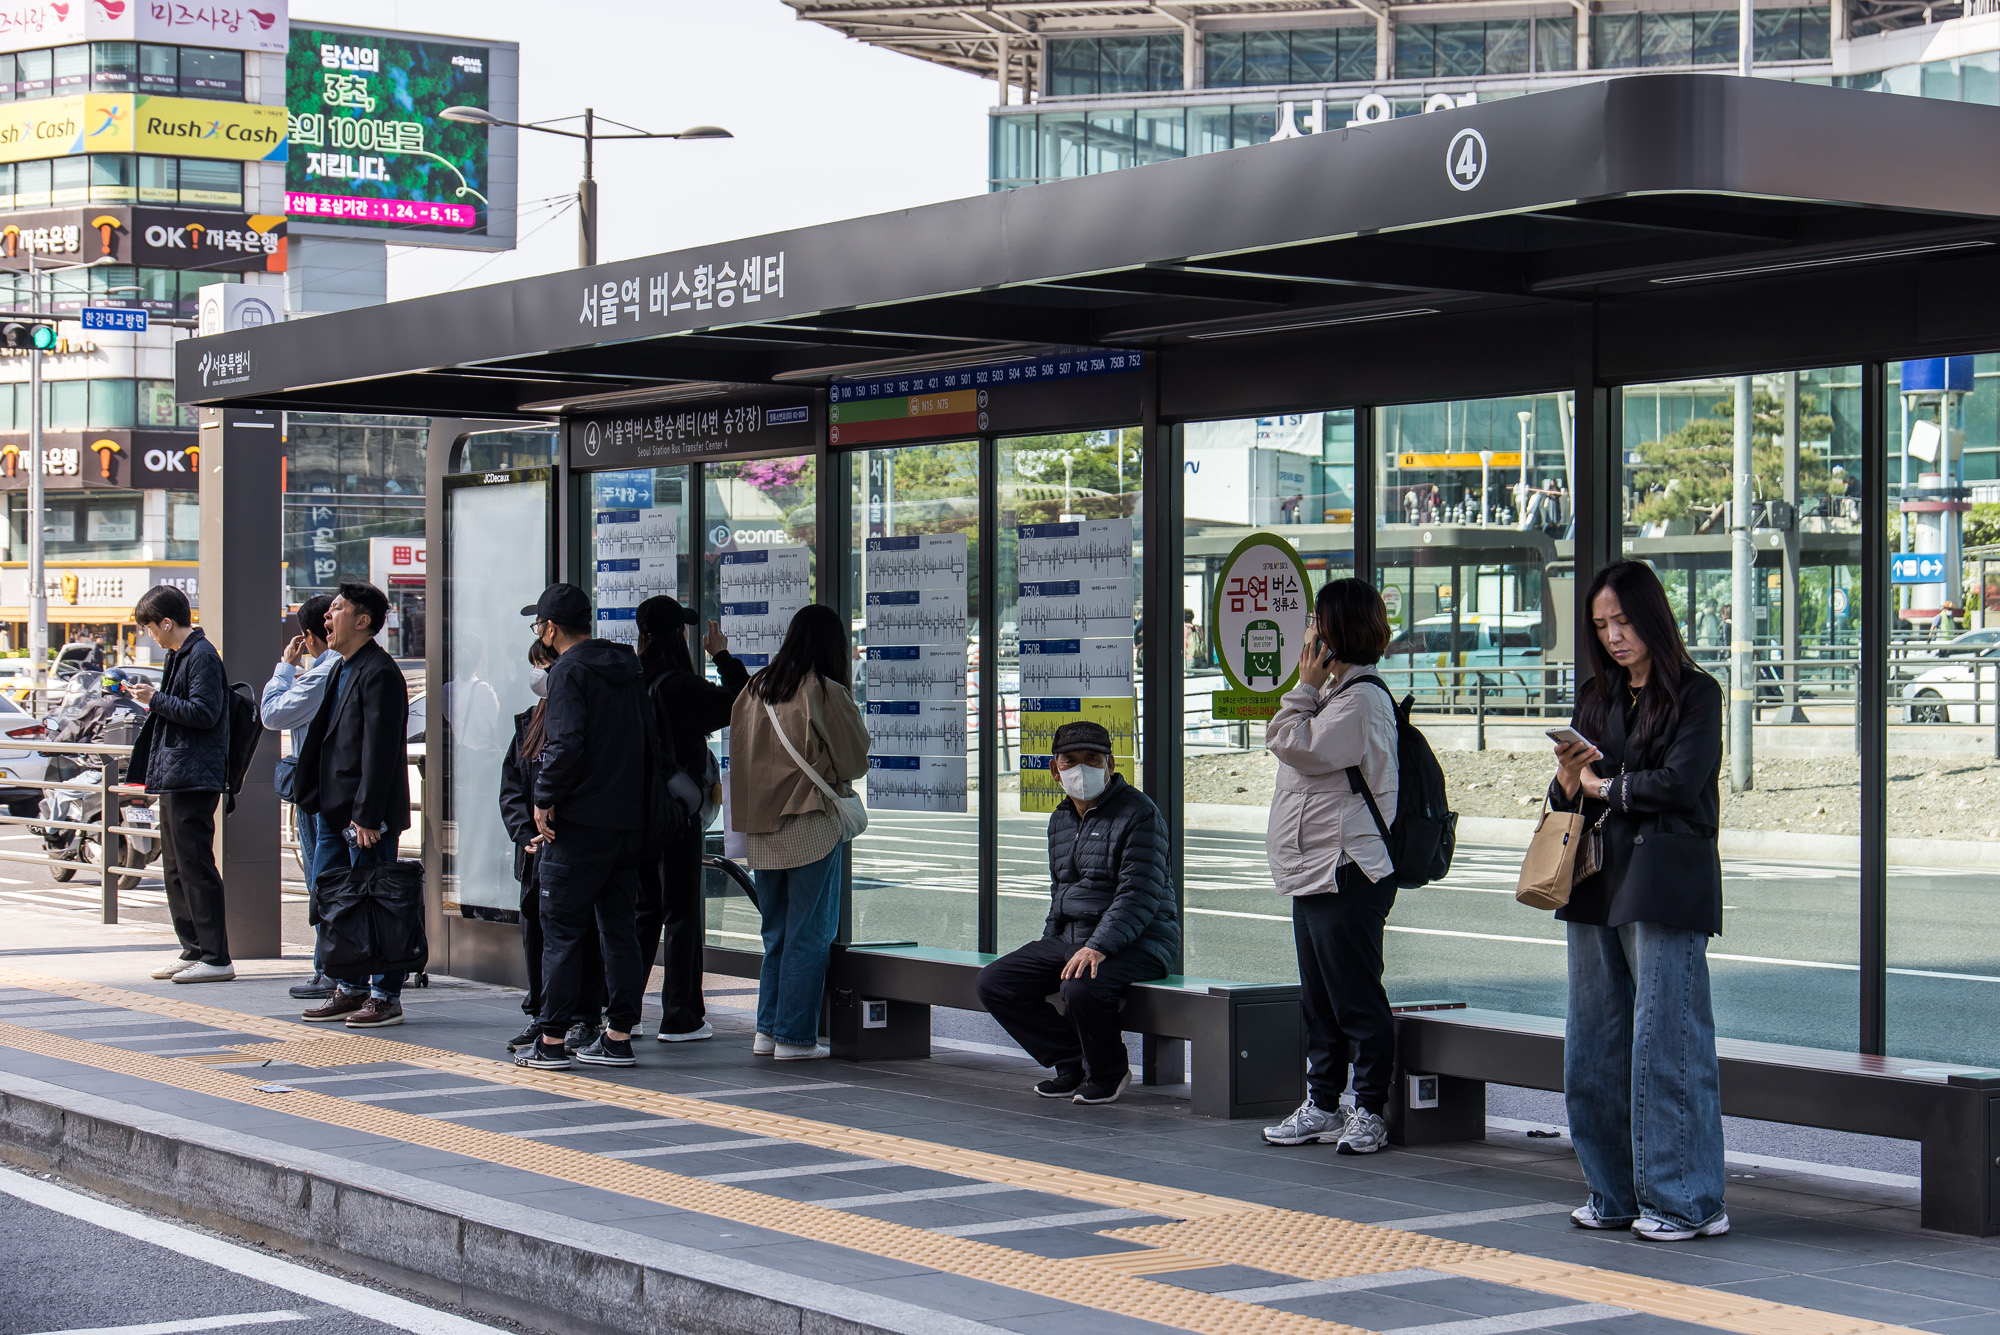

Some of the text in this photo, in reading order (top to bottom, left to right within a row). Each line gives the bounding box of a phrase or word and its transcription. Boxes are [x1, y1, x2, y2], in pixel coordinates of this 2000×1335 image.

[151, 2, 244, 33] 미즈사랑
[320, 44, 379, 73] 당신의
[323, 73, 375, 113] 3초,
[36, 117, 75, 139] Cash
[147, 117, 278, 144] Rush Cash
[328, 116, 424, 152] 100년을
[306, 152, 391, 182] 지킵니다.
[292, 195, 318, 213] 산불
[319, 198, 368, 216] 조심기간
[19, 225, 79, 253] 저축은행
[145, 225, 278, 254] OK 저축은행
[579, 251, 785, 328] 서울역 버스환승센터
[85, 311, 144, 329] 한강대교방면
[211, 349, 250, 377] 서울특별시
[841, 354, 1141, 398] 100 150 151 152 162 202 421 500 501 502 503 504 505 506 507 742 750A 750B 752
[921, 398, 949, 411] N15 N75
[723, 405, 762, 435] 승강장)
[637, 446, 651, 457] Seoul
[652, 445, 670, 455] Station
[671, 443, 680, 454] Bus
[682, 441, 704, 452] Transfer
[705, 439, 723, 451] Center
[144, 449, 185, 471] OK
[484, 473, 510, 484] JCDecaux
[600, 515, 610, 525] 100
[1022, 528, 1035, 541] 752
[869, 541, 881, 553] 504
[600, 563, 610, 573] 150
[723, 555, 734, 567] 421
[160, 577, 200, 599] MEG
[1023, 585, 1041, 599] 750A
[1227, 574, 1299, 613] 금연 버스
[869, 595, 881, 608] 505
[1272, 597, 1299, 613] 정류소
[1257, 621, 1267, 630] BUS
[869, 650, 882, 663] 506
[1023, 643, 1041, 657] 750B
[869, 704, 881, 717] 507
[1028, 699, 1041, 711] N15
[1028, 757, 1041, 769] N75
